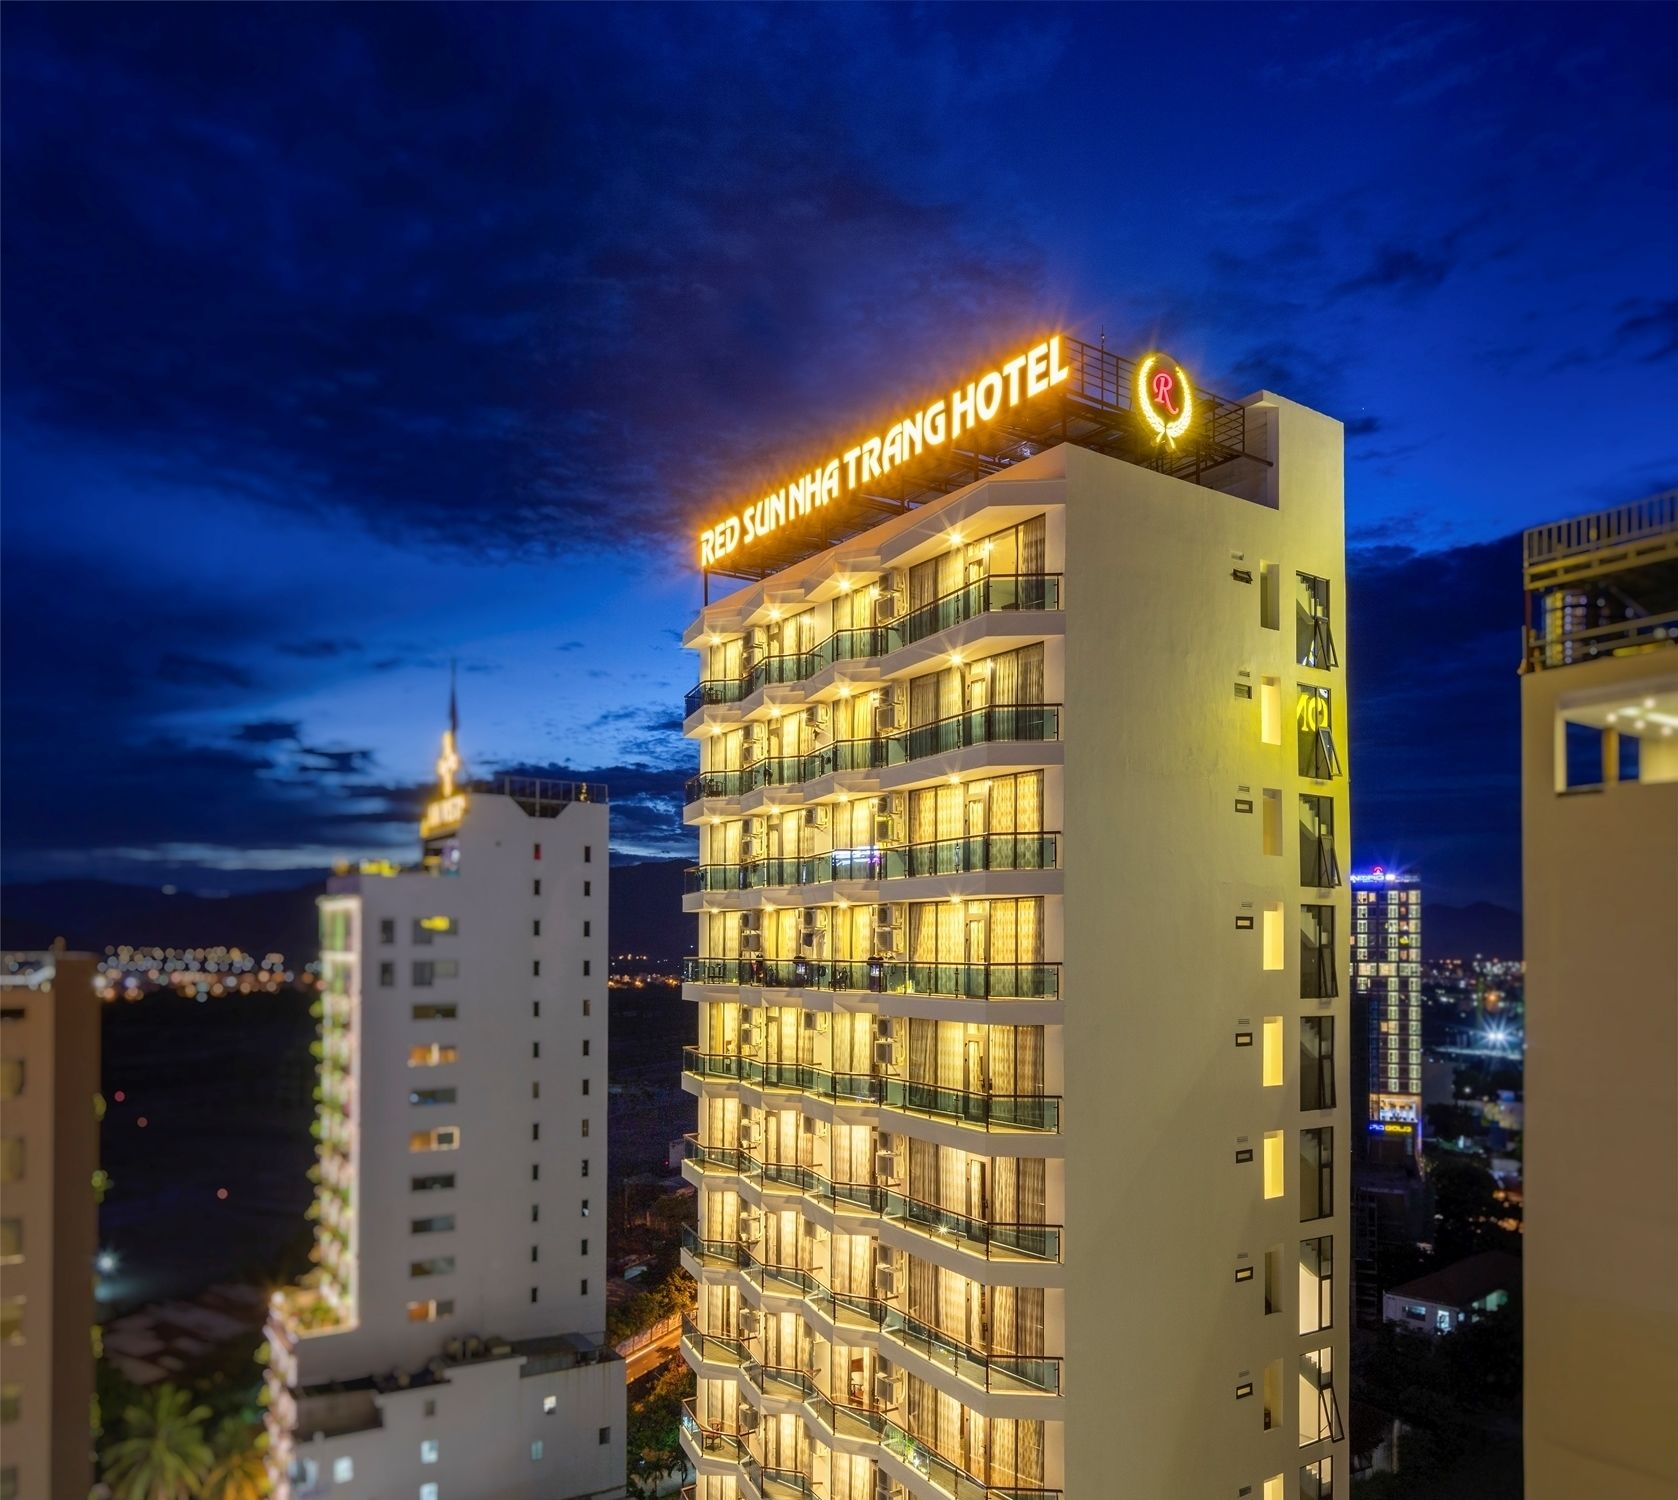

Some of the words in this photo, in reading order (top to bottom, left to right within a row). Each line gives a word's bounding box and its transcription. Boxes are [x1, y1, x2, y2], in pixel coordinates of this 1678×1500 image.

[700, 515, 740, 568] RED
[743, 488, 786, 545] SUN
[788, 458, 840, 522] NHA
[843, 399, 946, 490] TRANG
[952, 335, 1070, 440] HOTEL
[1152, 372, 1180, 415] R
